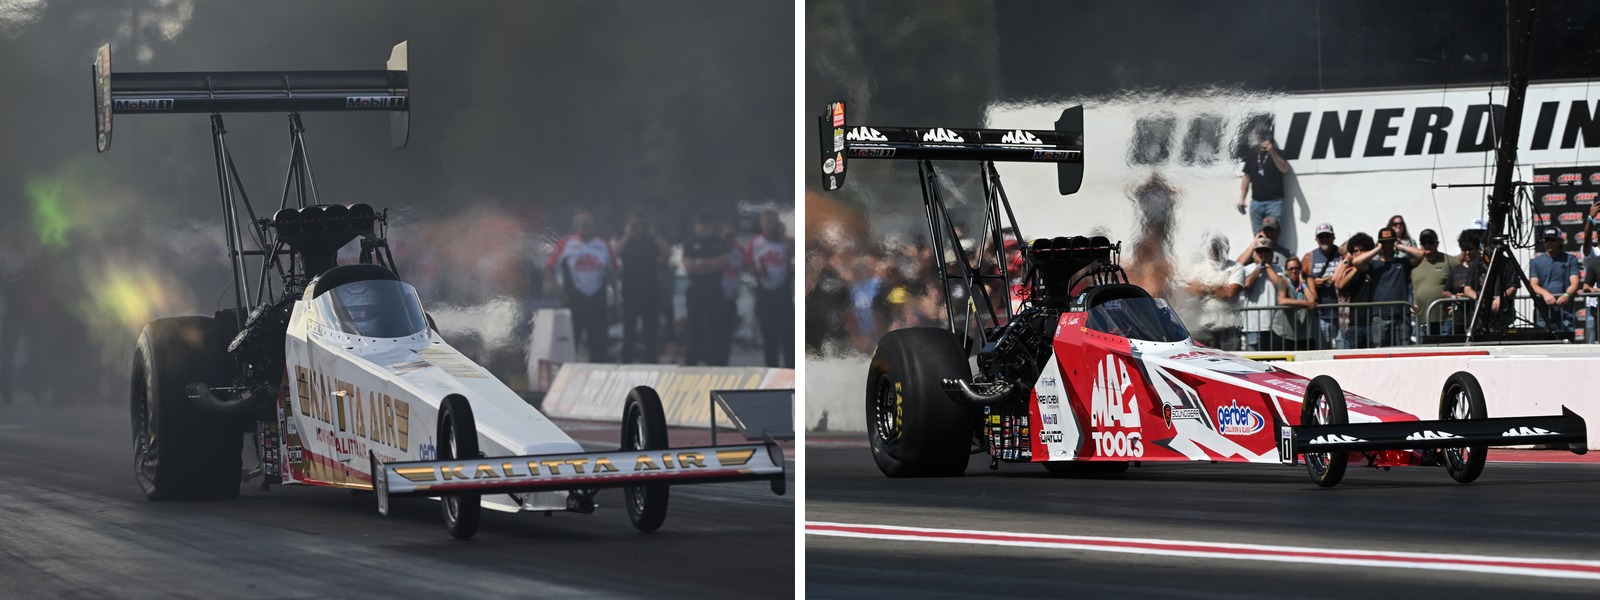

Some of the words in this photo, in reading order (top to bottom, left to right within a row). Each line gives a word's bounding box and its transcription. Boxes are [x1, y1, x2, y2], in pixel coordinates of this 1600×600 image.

[115, 100, 156, 110] Mobil
[347, 97, 388, 107] Mobil
[846, 126, 888, 141] MAC
[923, 127, 965, 143] MAC
[1001, 129, 1043, 144] MAC
[848, 148, 882, 157] Mobil
[1034, 151, 1066, 159] Mobil
[1091, 353, 1142, 429] MAC
[369, 391, 398, 449] AIR
[1171, 409, 1199, 418] SOUNDGEAR
[1217, 401, 1251, 433] gerber
[1406, 430, 1467, 440] MAC
[1502, 426, 1561, 437] MAC
[1091, 430, 1144, 458] TOOLS
[1309, 434, 1369, 444] MAC
[440, 457, 620, 481] KALITTA
[633, 452, 708, 472] AIR
